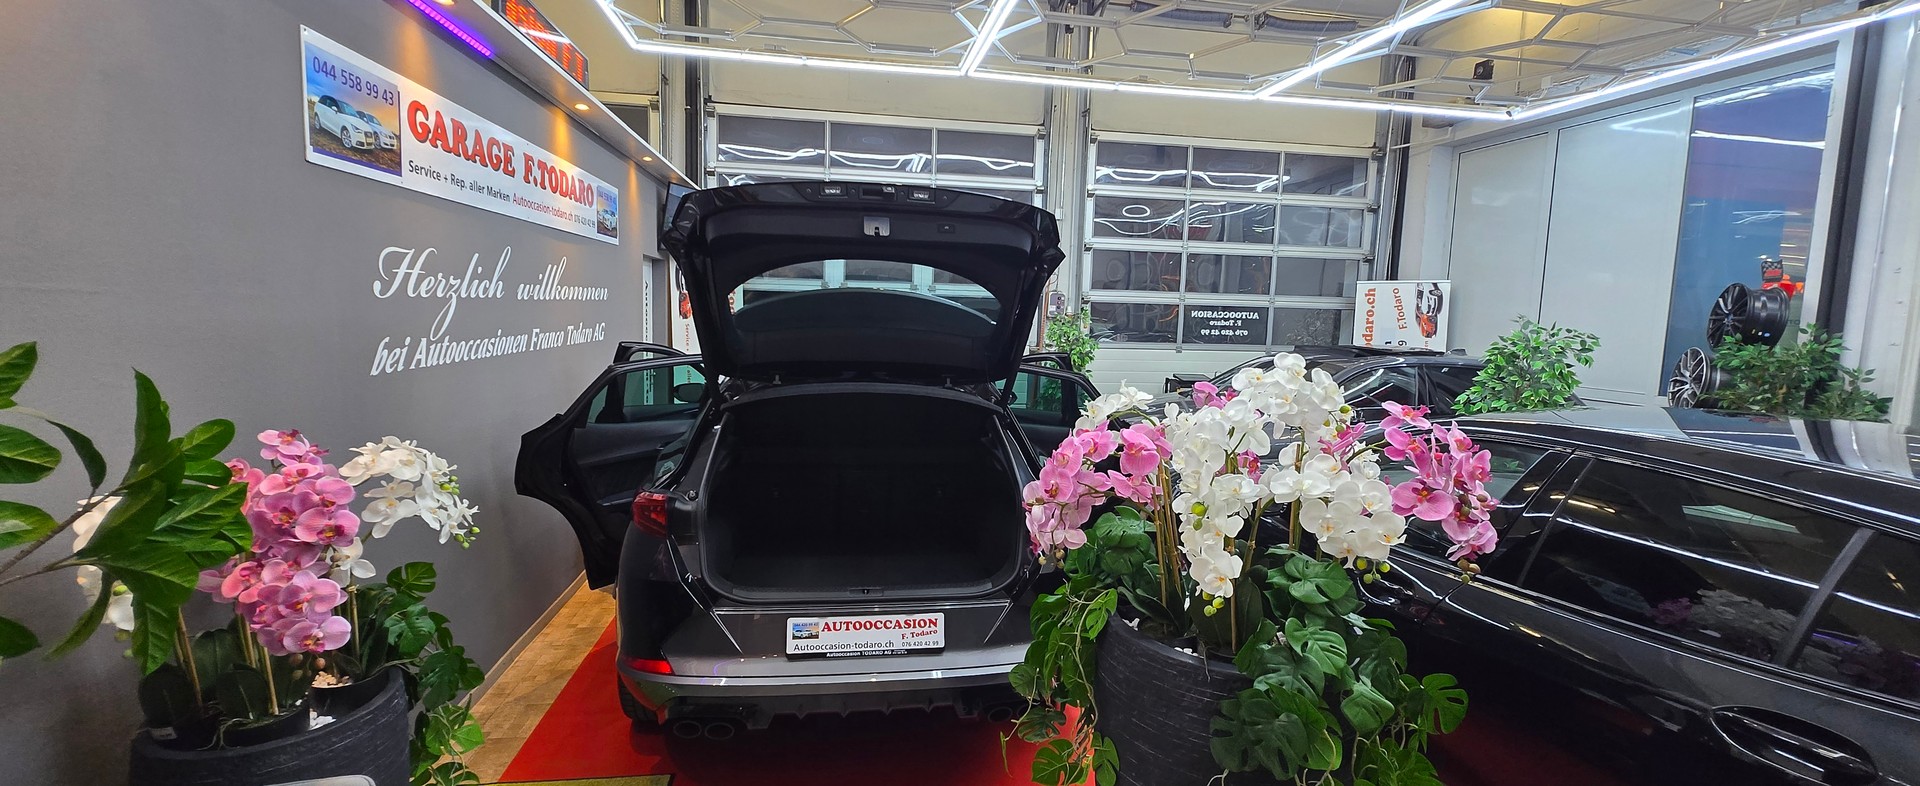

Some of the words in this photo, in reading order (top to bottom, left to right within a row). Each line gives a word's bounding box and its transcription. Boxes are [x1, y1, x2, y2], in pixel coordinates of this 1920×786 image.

[312, 56, 337, 81] 044
[341, 69, 362, 92] 558
[365, 81, 379, 99] 99
[382, 89, 394, 106] 43
[407, 100, 516, 178] GARAGE
[523, 152, 594, 208] F.TODARO
[408, 160, 441, 181] Service
[443, 174, 449, 183] +
[450, 173, 468, 191] Rep.
[469, 180, 485, 194] aller
[486, 185, 510, 202] Marken
[513, 192, 573, 222] Autooccasion-todaro.ch
[373, 246, 511, 341] Herzlich
[517, 256, 608, 301] willkommen
[370, 336, 410, 376] bei
[409, 328, 528, 370] Autooccasionen
[529, 328, 564, 352] Franco
[566, 321, 593, 346] Todaro
[592, 322, 606, 342] AG
[793, 640, 894, 652] Autooccasion-todaro.ch
[821, 618, 938, 632] AUTOOCCASION
[910, 629, 938, 639] Todaro
